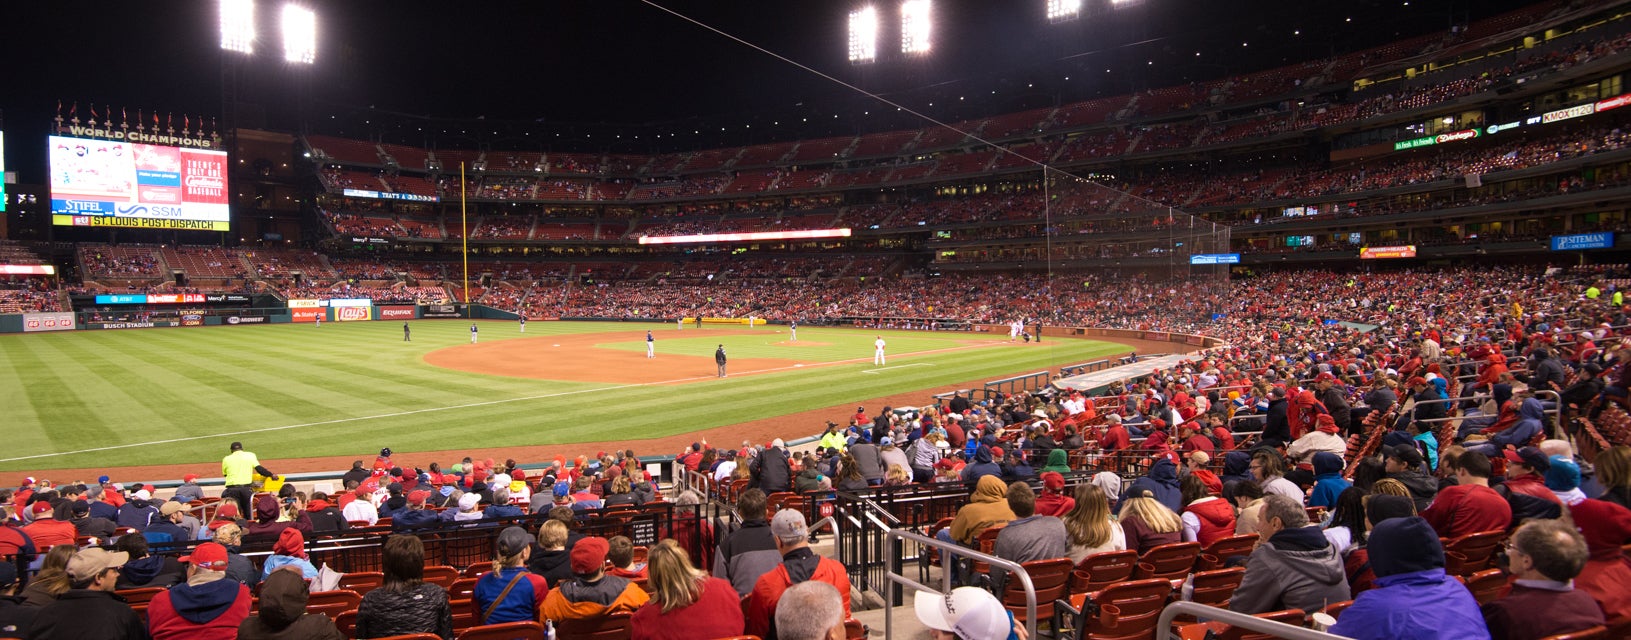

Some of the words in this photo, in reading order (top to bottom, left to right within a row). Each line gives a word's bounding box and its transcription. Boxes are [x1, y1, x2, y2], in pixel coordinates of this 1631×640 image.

[69, 125, 124, 139] WORLD
[127, 132, 211, 147] CHAMPIONS
[188, 187, 221, 196] BASEBALL
[65, 200, 102, 211] STIFEL
[151, 206, 181, 216] SSM
[94, 216, 109, 226] ST.
[110, 217, 138, 227] LOUIS
[142, 218, 214, 229] POST-DISPATCH
[1568, 234, 1604, 244] SITEMAN
[822, 506, 832, 514] 161
